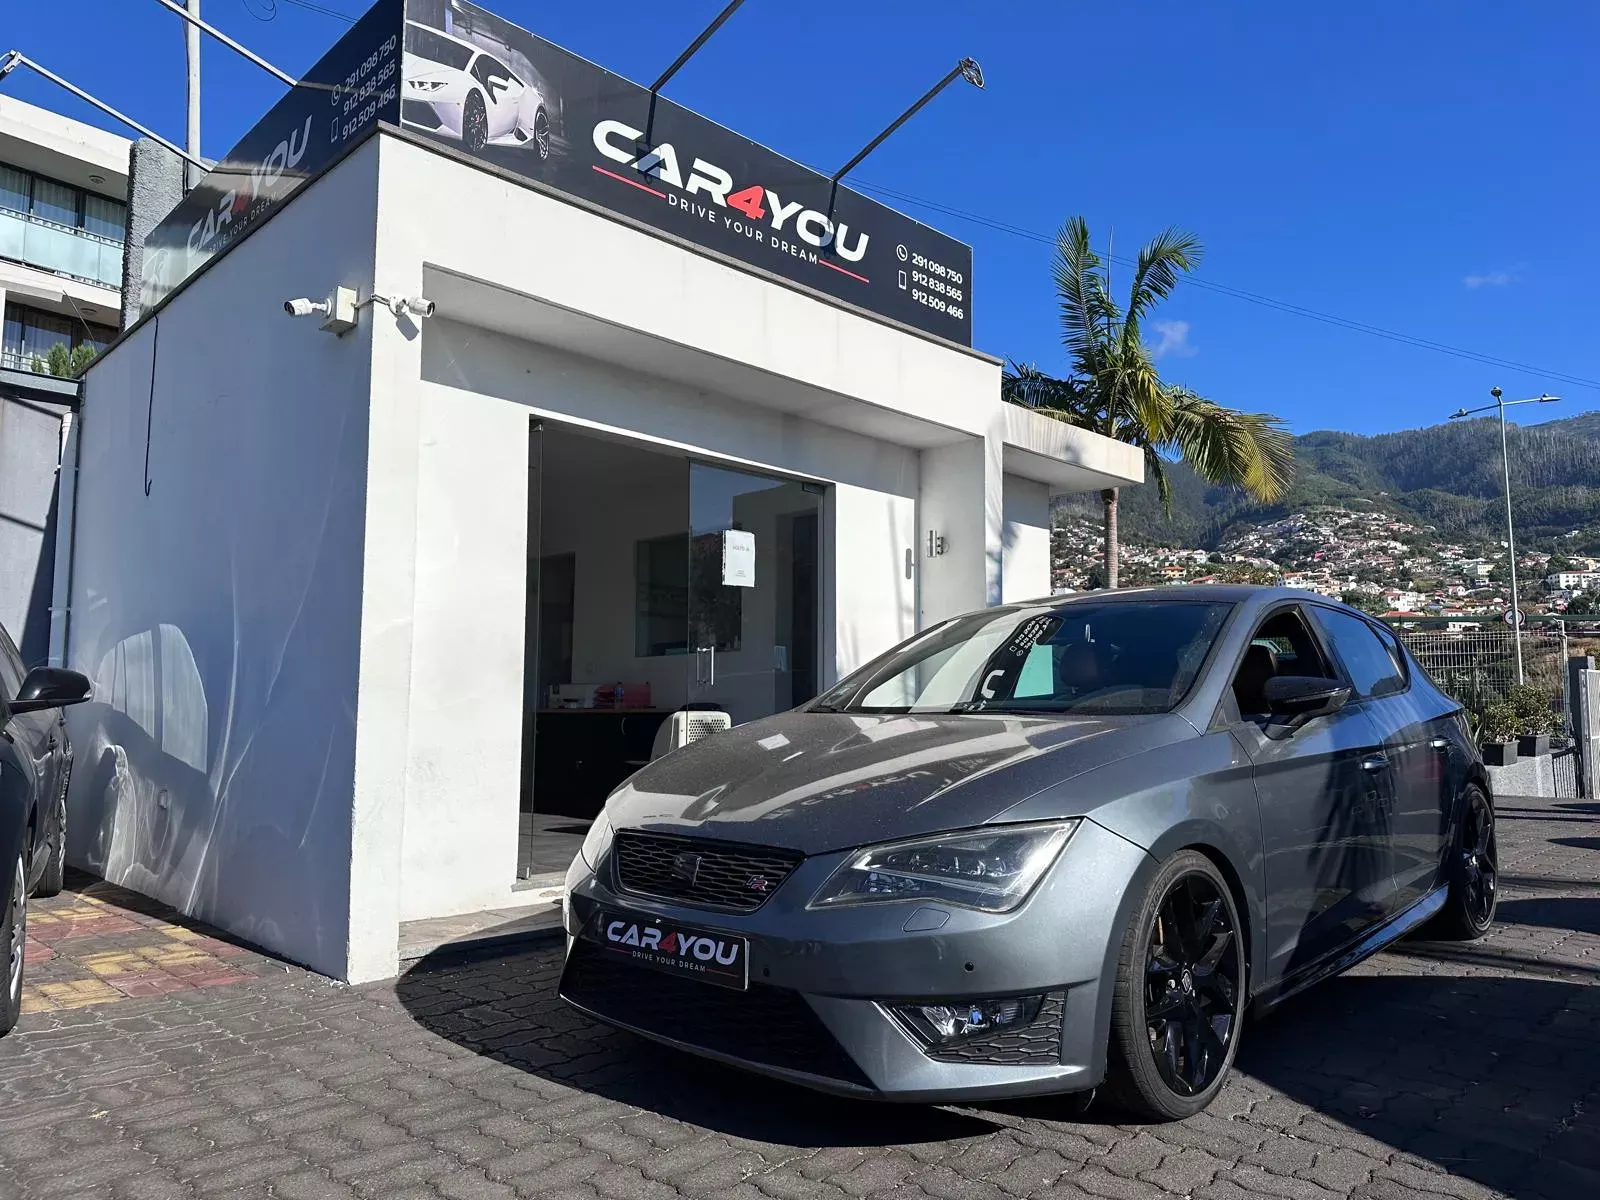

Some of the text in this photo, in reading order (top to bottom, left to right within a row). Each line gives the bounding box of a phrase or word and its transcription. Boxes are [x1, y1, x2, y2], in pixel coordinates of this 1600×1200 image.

[345, 34, 396, 93] 291 098 750
[343, 58, 395, 116] 912 838 565
[342, 83, 396, 141] 912 509 466
[592, 119, 870, 262] CAR4YOU
[229, 216, 248, 237] YOUR
[668, 194, 818, 265] DRIVE YOUR DREAM
[912, 252, 963, 284] 291 098 750
[912, 270, 963, 301] 912 838 565
[912, 288, 964, 320] 912 509 466
[606, 920, 739, 965] CAR4YOU
[632, 950, 706, 973] DRIVE YOUR DREAM
